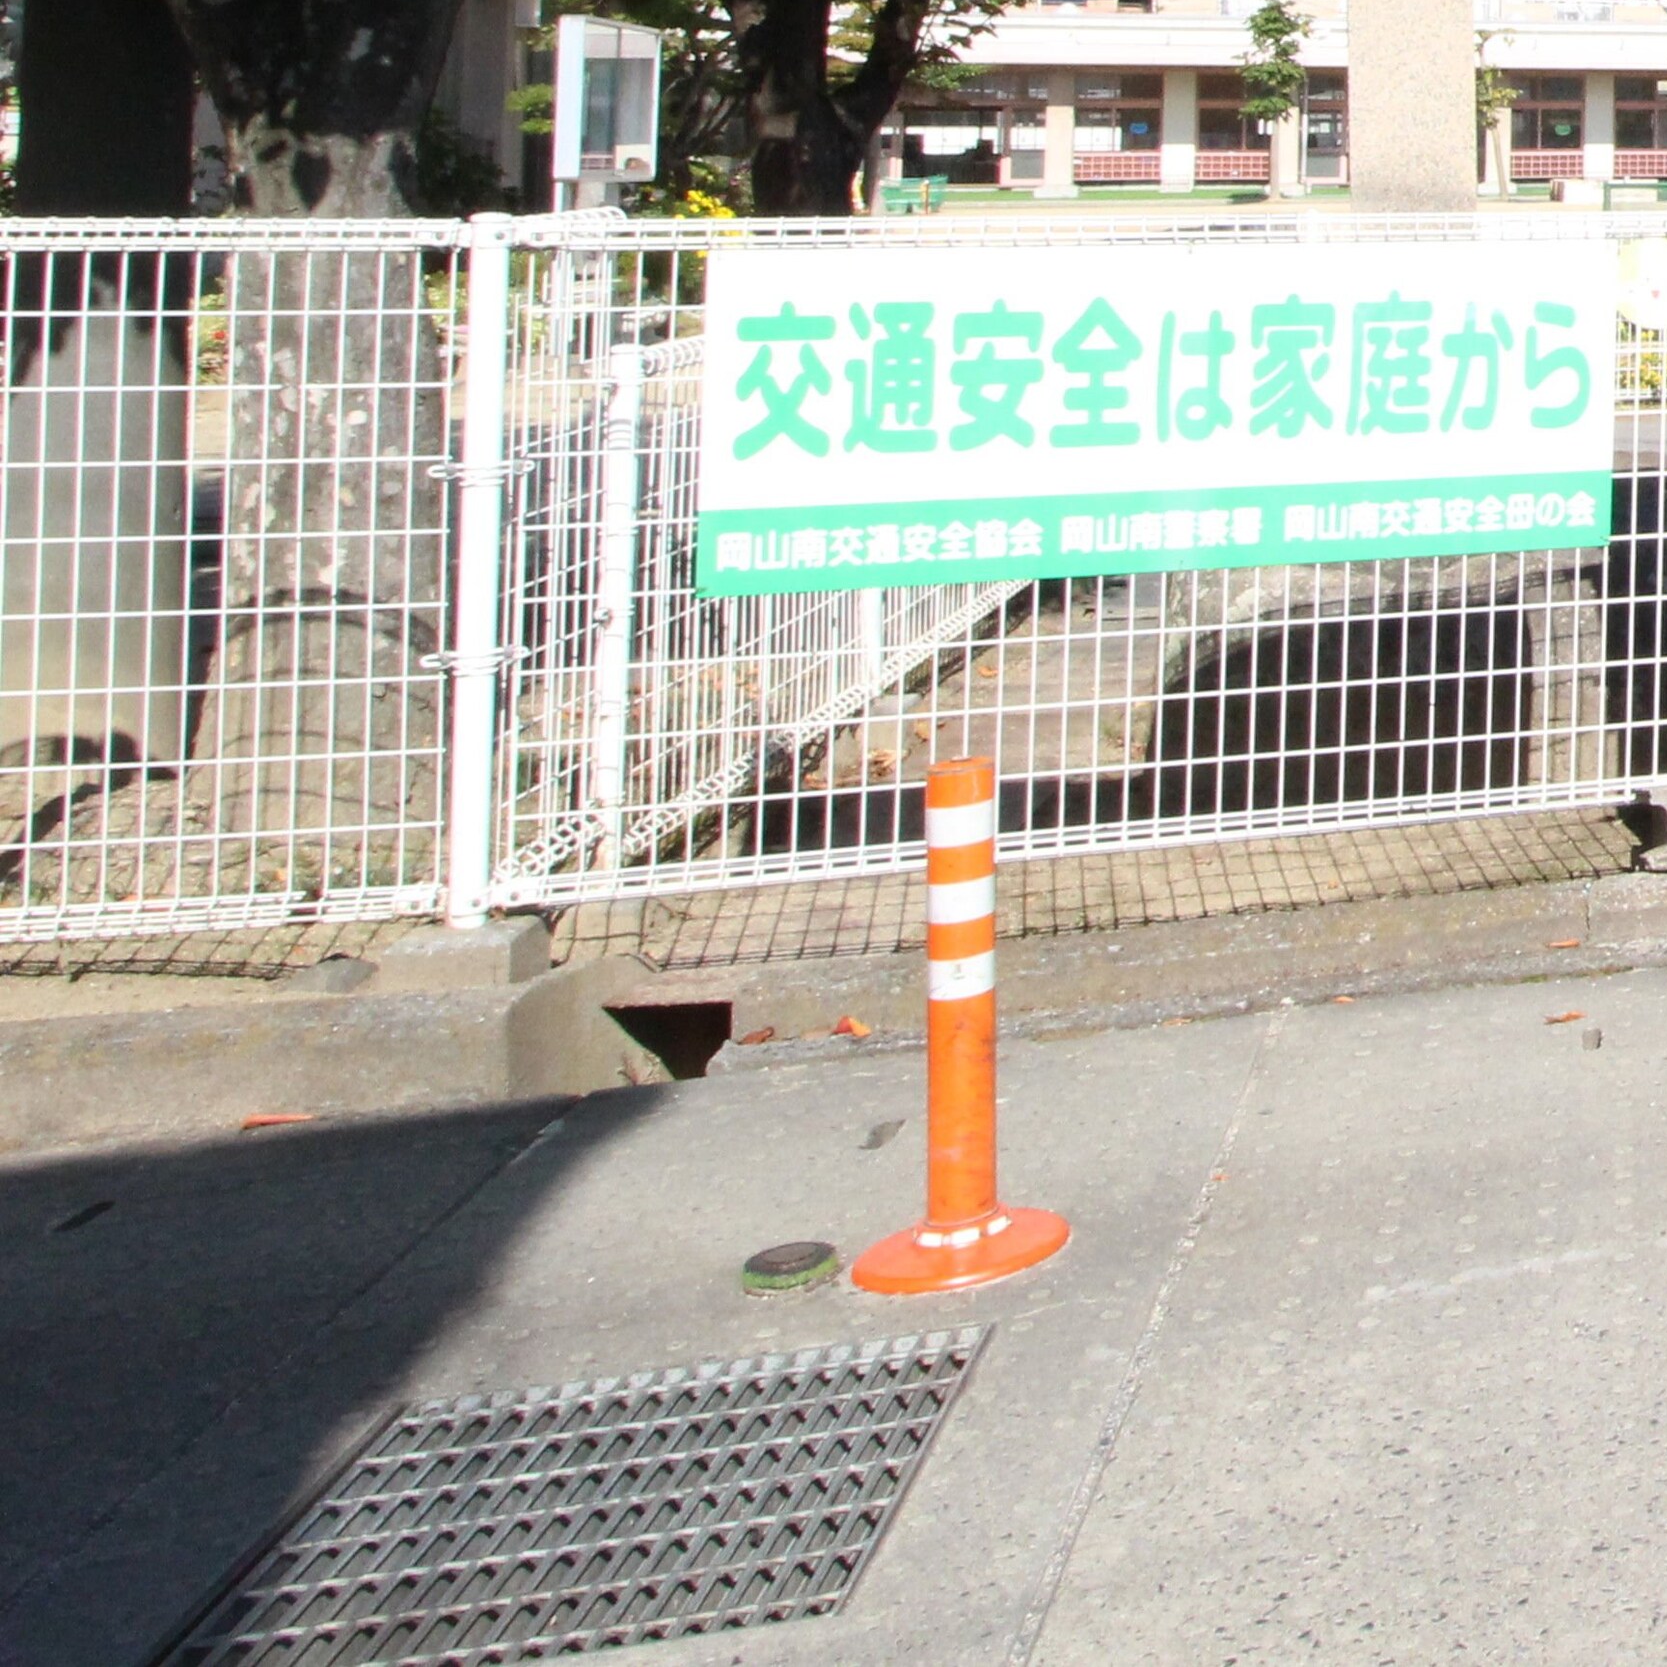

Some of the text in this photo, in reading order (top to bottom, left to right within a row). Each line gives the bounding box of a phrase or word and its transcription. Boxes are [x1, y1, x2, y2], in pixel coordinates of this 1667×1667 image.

[731, 291, 1591, 461] 交通安全は家庭から
[1060, 506, 1263, 555] 岡山南警察署
[1284, 490, 1597, 543] 岡山南交通安全母の会
[715, 517, 1044, 573] 岡山南交通安全協会
